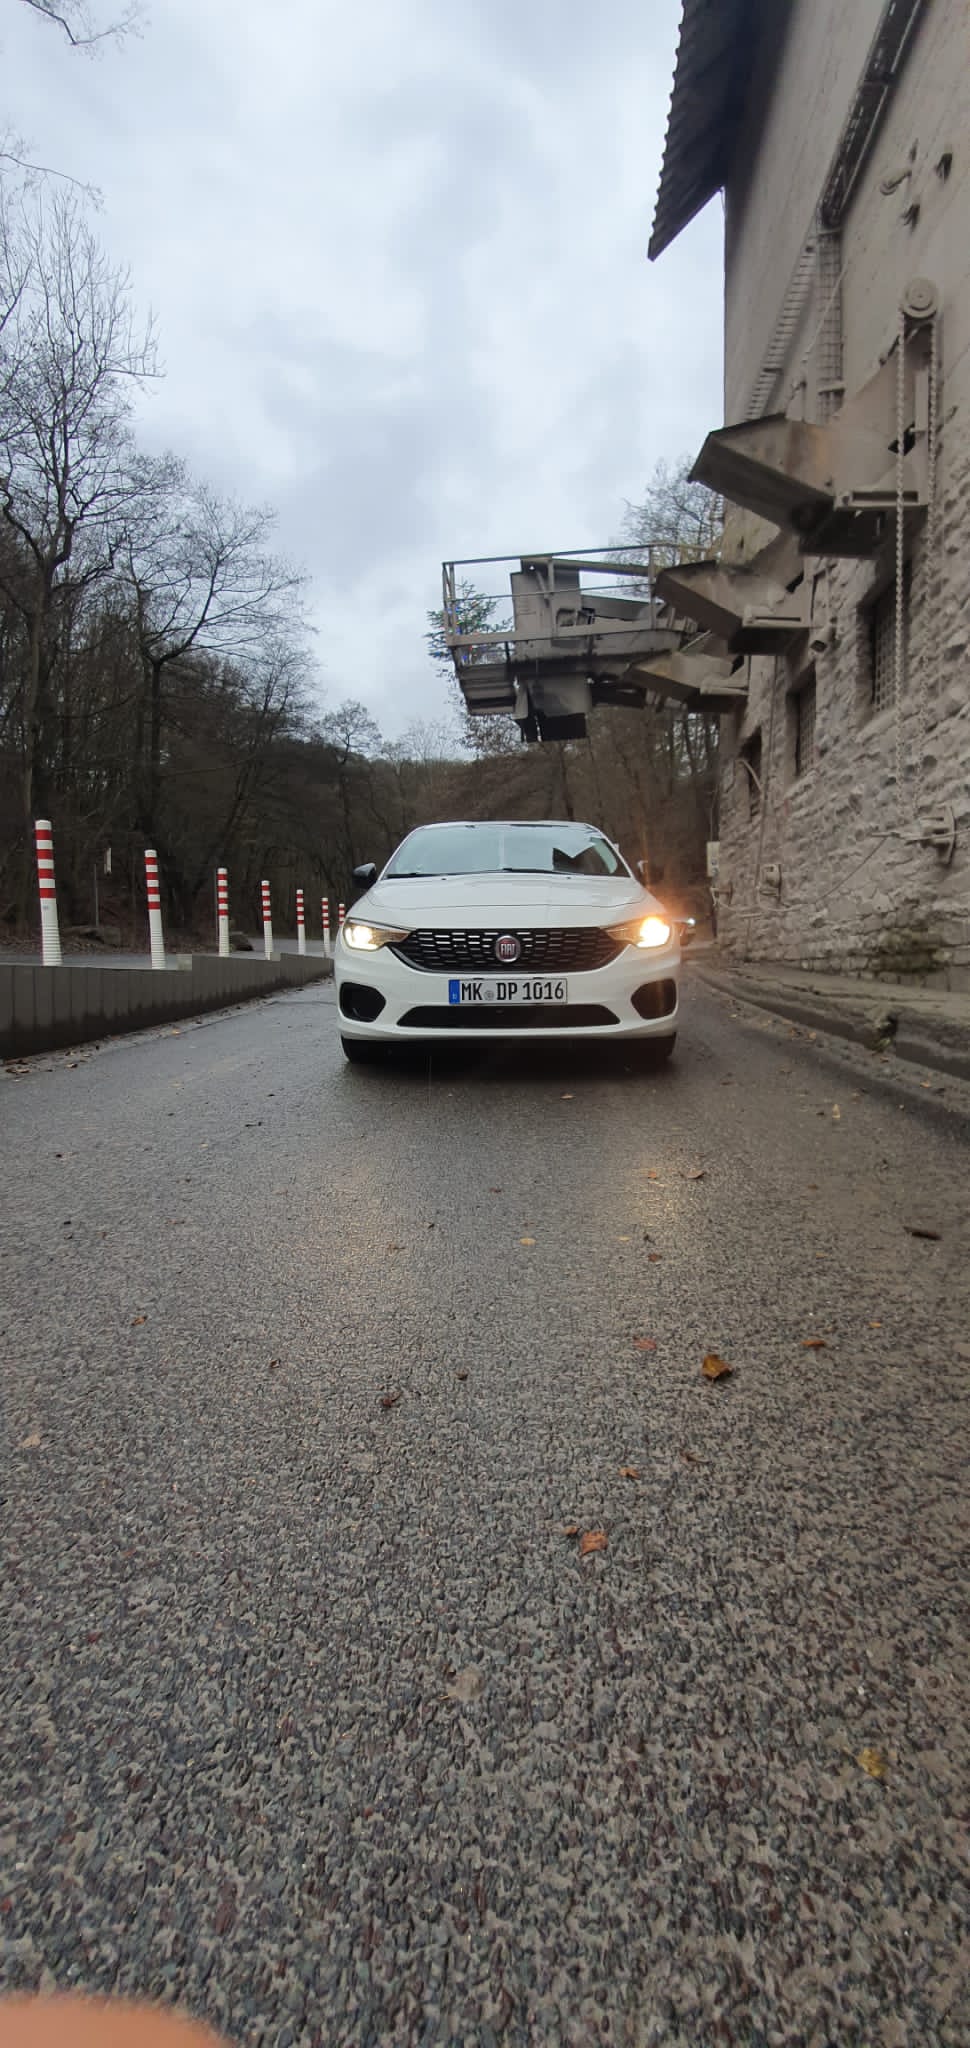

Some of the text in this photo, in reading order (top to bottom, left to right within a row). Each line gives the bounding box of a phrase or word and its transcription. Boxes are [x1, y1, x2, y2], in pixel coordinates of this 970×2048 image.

[501, 943, 515, 956] FIAT
[461, 982, 564, 1001] MK DP 1016
